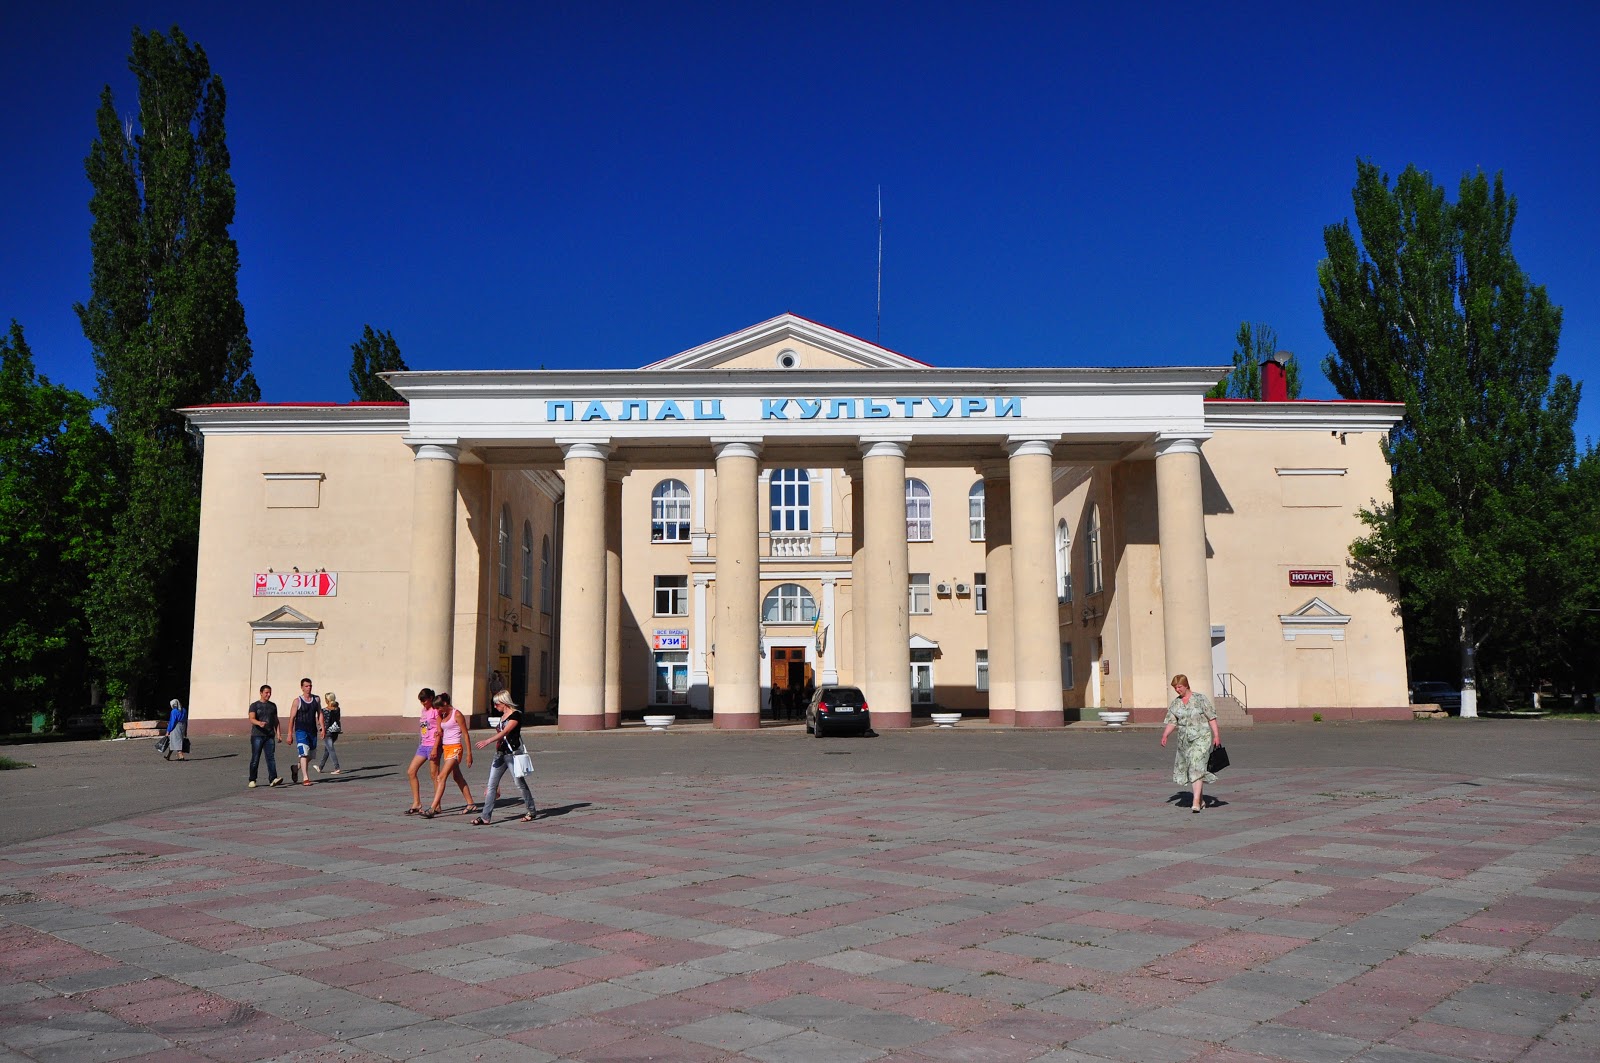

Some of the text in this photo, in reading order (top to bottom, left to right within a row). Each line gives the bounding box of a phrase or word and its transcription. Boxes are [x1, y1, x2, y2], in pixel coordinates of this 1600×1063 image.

[547, 397, 1021, 421] ПАЛАЦ КУЛЬТУРИ
[277, 574, 317, 591] УЗИ
